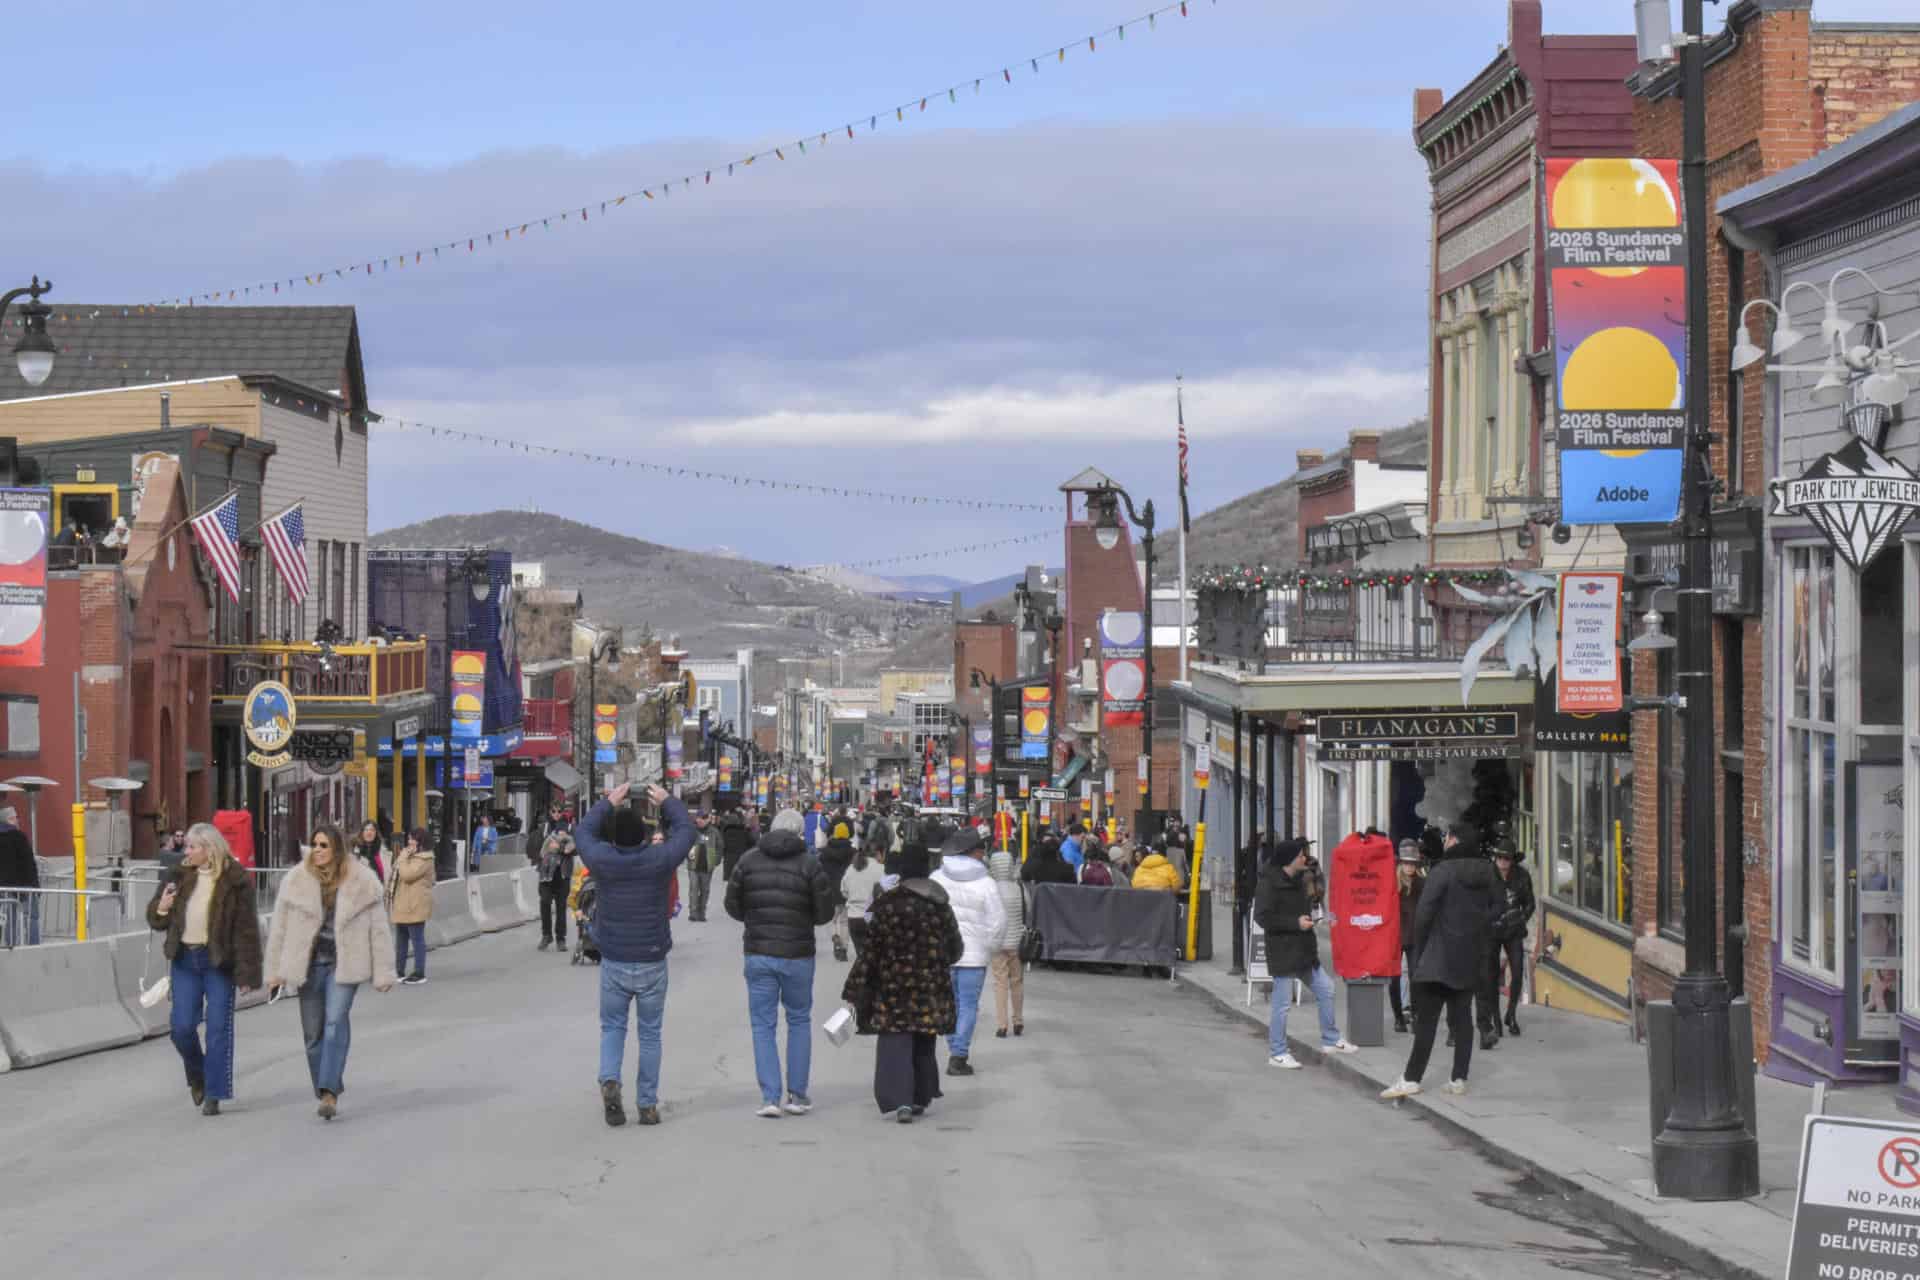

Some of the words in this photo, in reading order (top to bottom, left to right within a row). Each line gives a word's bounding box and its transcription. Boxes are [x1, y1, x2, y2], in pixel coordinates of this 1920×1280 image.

[1550, 231, 1593, 248] 2026
[1596, 230, 1683, 247] Sundance
[1564, 247, 1601, 263] Film
[1604, 246, 1671, 262] Festival
[1559, 413, 1602, 429] 2026
[1605, 412, 1685, 428] Sundance
[1573, 429, 1609, 445] Film
[1612, 428, 1673, 445] Festival
[1595, 486, 1649, 502] Adobe
[1794, 481, 1825, 501] PARK
[1829, 479, 1857, 499] CITY
[1568, 601, 1579, 609] NO
[1580, 601, 1612, 609] PARKING
[1341, 717, 1497, 736] FLANAGAN'S
[1536, 730, 1595, 741] GALLERY
[1416, 747, 1508, 760] RESTAURANT
[1847, 1189, 1872, 1204] NO
[1819, 1233, 1919, 1257] DELIVERIES
[1818, 1263, 1844, 1279] NO
